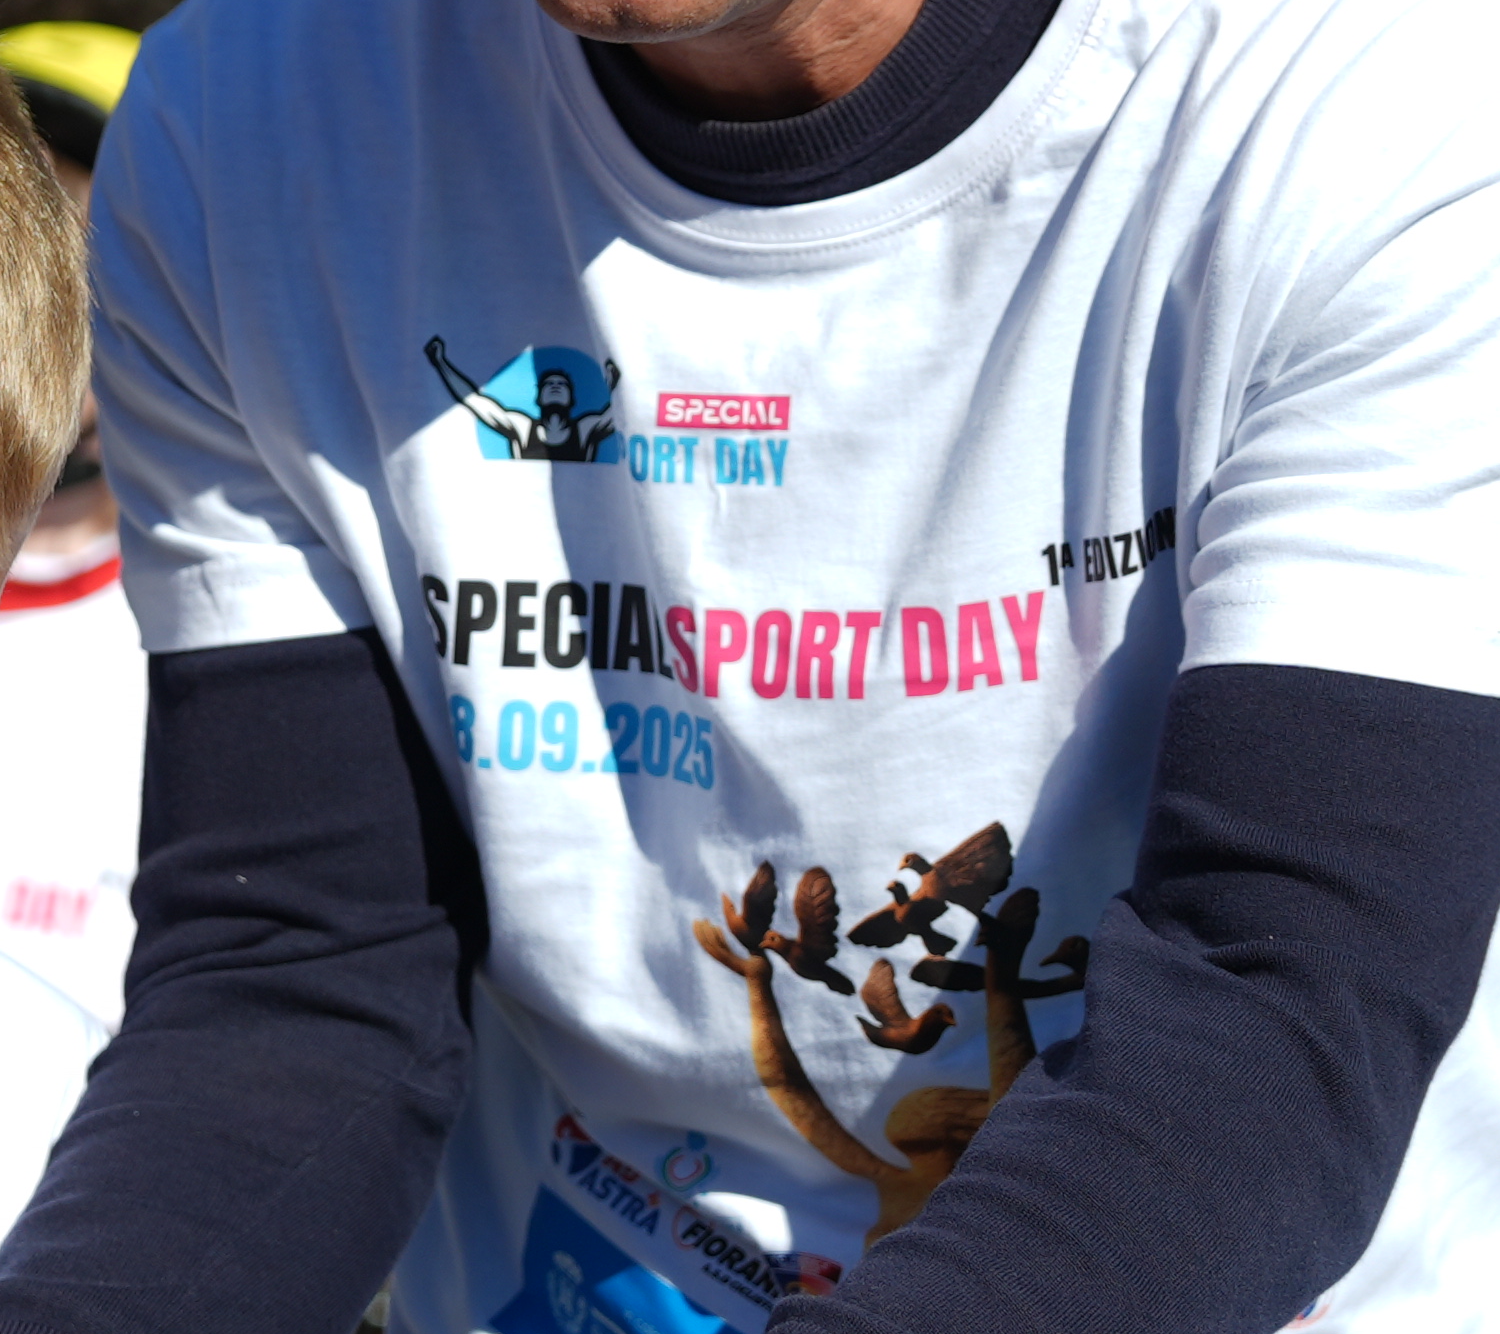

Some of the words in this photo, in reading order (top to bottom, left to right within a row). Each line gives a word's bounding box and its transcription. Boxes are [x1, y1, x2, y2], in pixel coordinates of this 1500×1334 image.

[664, 398, 783, 425] SPECIAL
[620, 432, 699, 484] ORT
[714, 436, 789, 487] DAY
[1083, 506, 1177, 582] EDIZION
[421, 573, 674, 680] SPECIAL
[665, 605, 882, 701] SPORT
[900, 590, 1045, 698] DAY
[450, 694, 716, 791] 8.09.2025
[577, 1167, 661, 1236] ASTRA
